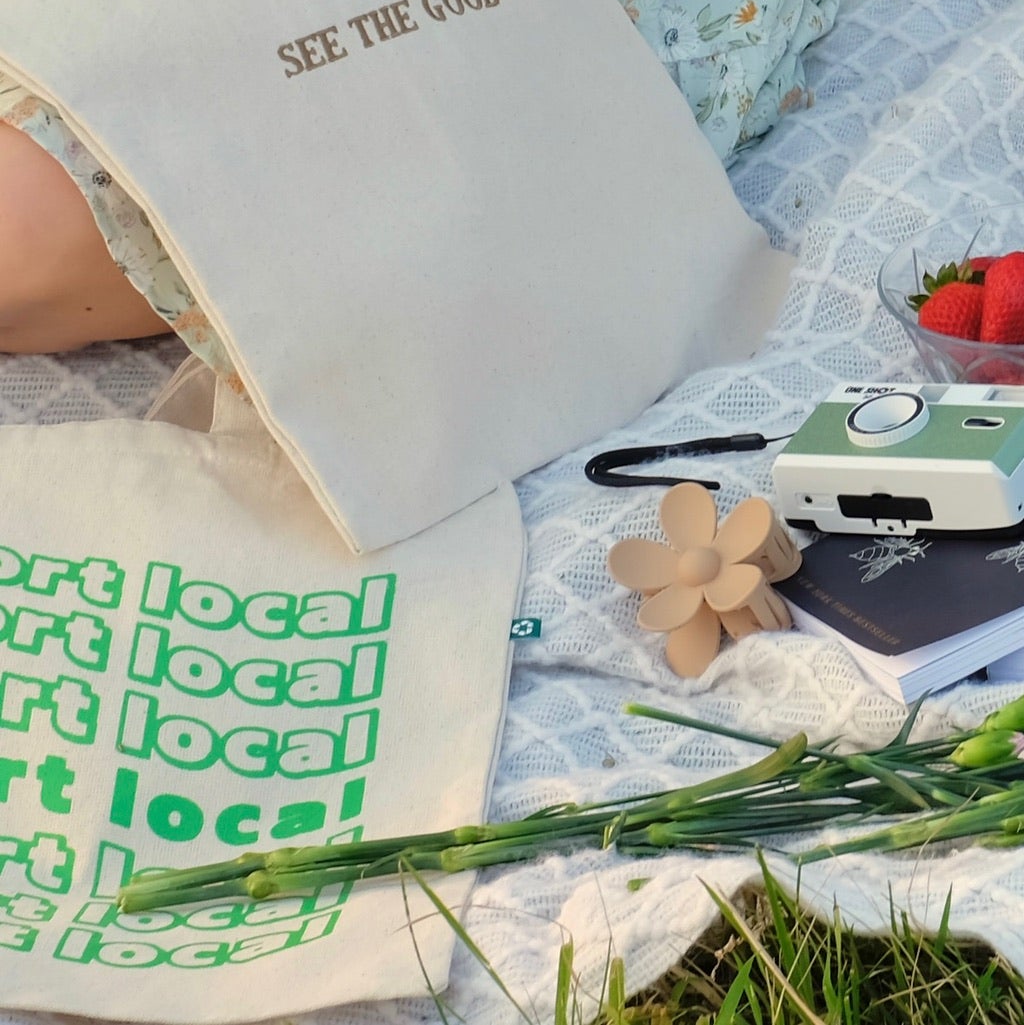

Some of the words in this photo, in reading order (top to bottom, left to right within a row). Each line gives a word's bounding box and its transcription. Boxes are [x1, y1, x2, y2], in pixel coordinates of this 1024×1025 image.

[277, 26, 348, 78] SEE
[348, 0, 419, 49] THE
[140, 561, 397, 639] local
[0, 604, 112, 672] rt
[128, 622, 387, 708] local
[116, 689, 379, 779] local
[110, 767, 366, 847] local
[53, 910, 342, 969] local
